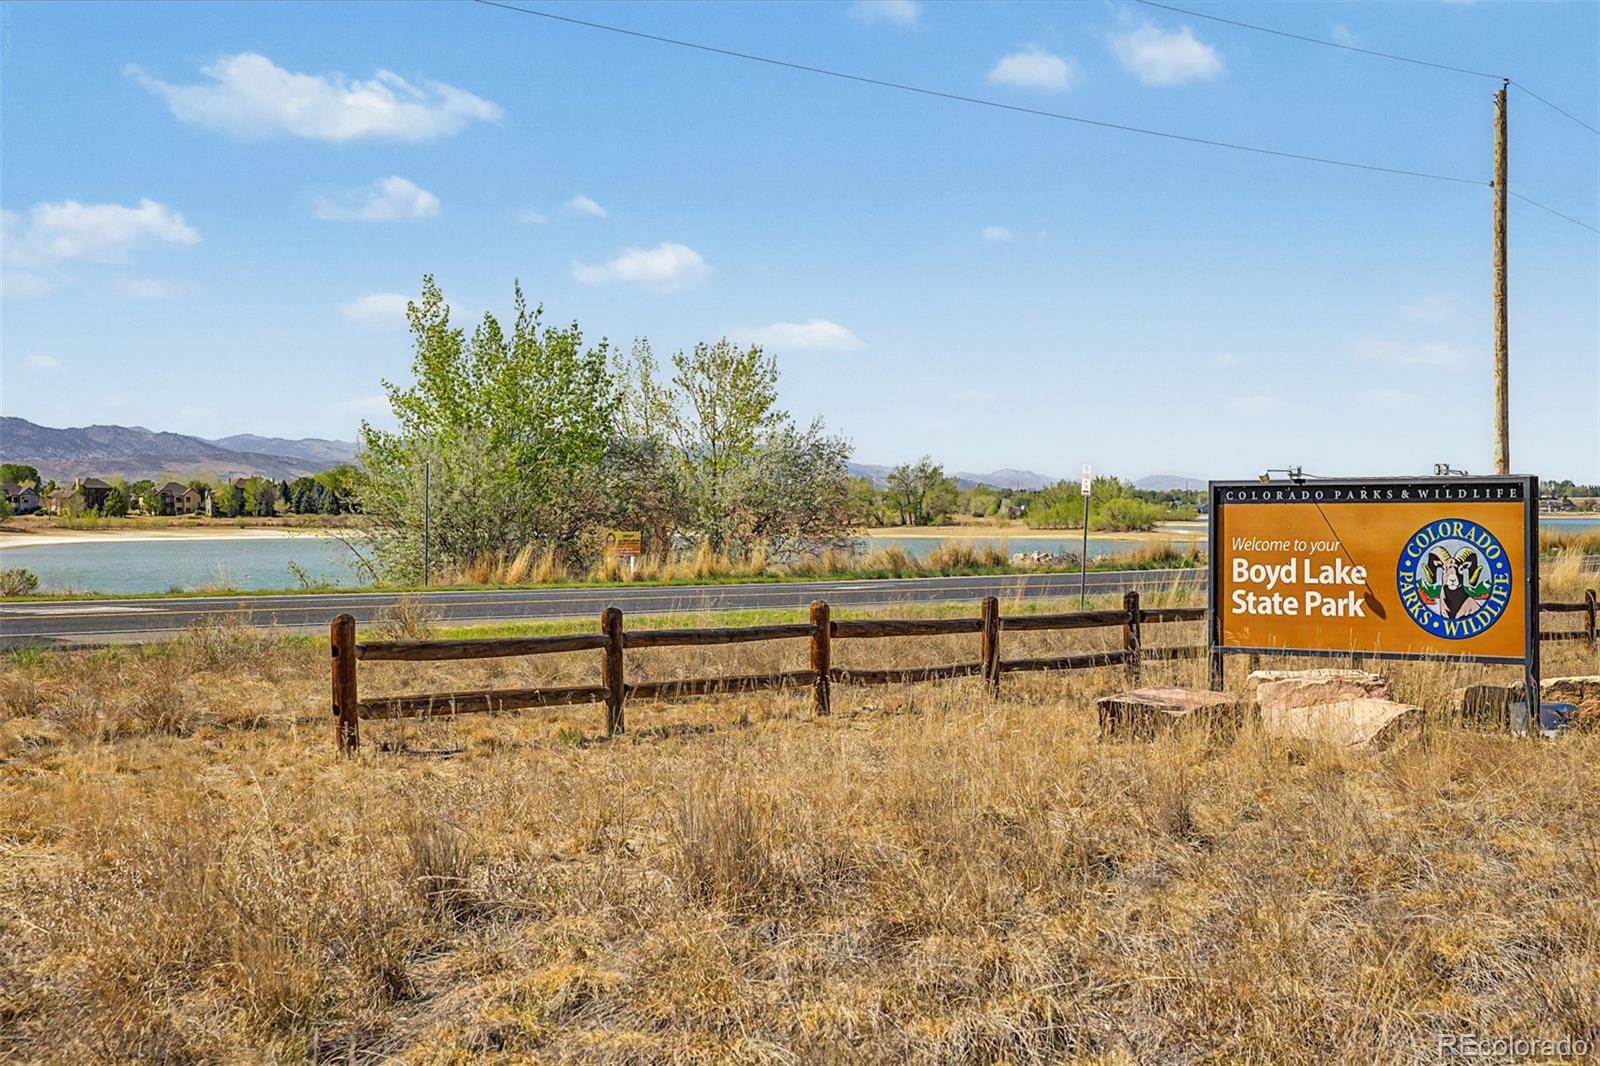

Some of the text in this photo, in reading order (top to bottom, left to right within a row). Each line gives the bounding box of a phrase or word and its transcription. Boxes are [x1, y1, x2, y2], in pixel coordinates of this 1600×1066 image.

[1226, 487, 1518, 501] COLORADO PARKS & WILDLIFE
[1231, 537, 1341, 556] Welcome to your
[1407, 521, 1501, 561] COLORADO
[1231, 557, 1367, 590] Boyd Lake
[1231, 590, 1367, 617] State Park
[1399, 570, 1432, 626] PARKS
[1442, 572, 1509, 637] WILDLIFE
